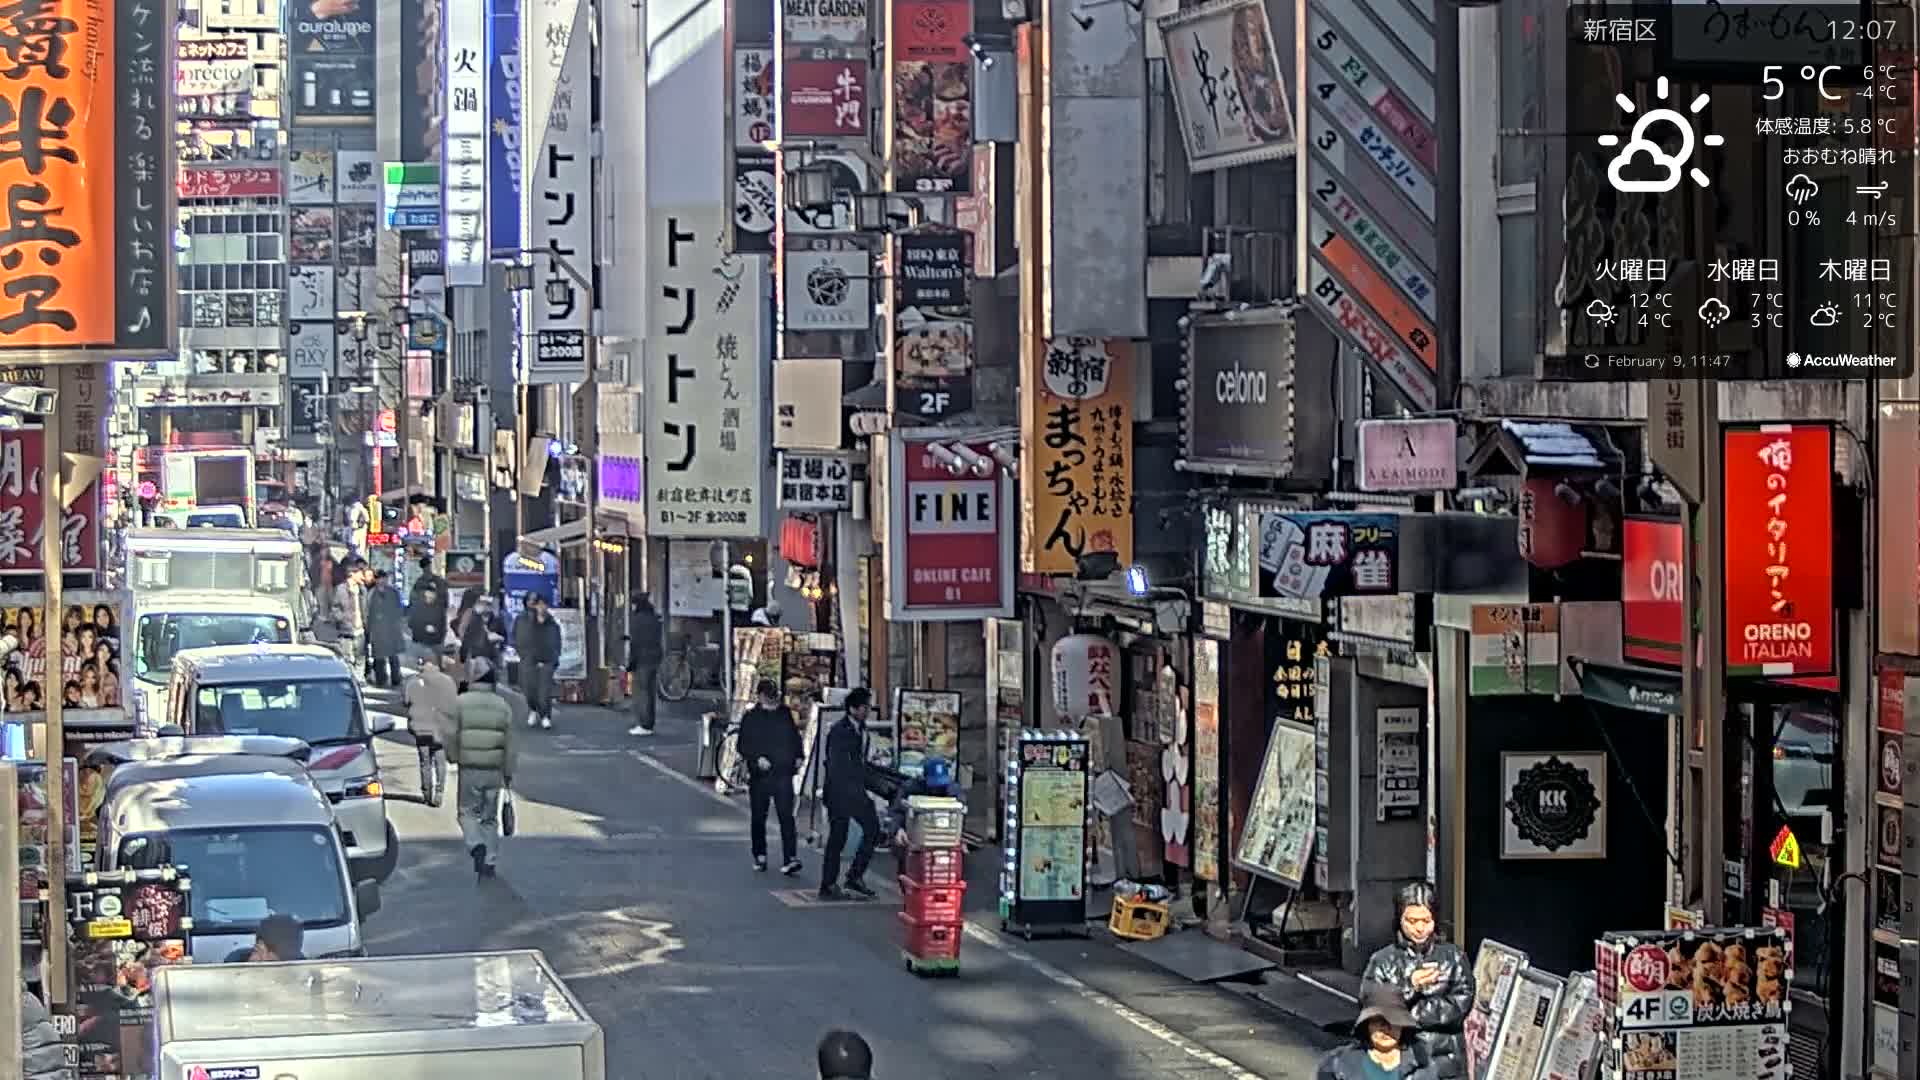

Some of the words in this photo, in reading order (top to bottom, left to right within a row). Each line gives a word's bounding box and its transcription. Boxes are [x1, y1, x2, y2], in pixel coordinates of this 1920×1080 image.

[819, 0, 866, 17] GARDEN
[1317, 29, 1338, 50] 5
[1317, 83, 1337, 100] 4
[1317, 129, 1337, 151] 3
[1359, 125, 1416, 188] センチュリー
[1316, 180, 1337, 202] 2
[1315, 277, 1343, 306] B1
[662, 217, 697, 472] トントン
[1067, 380, 1088, 396] の
[919, 392, 951, 414] 2F
[1397, 429, 1417, 458] A
[1044, 403, 1089, 559] まっちゃん
[1404, 467, 1448, 481] MODE
[915, 493, 990, 521] FINE
[1353, 527, 1394, 543] フリー
[1757, 438, 1793, 614] 俺のイタリアン
[960, 567, 993, 584] CAFE
[1743, 622, 1812, 642] ORENO
[1743, 642, 1812, 660] ITALIAN
[1539, 789, 1568, 807] KK
[1626, 997, 1661, 1021] 4F
